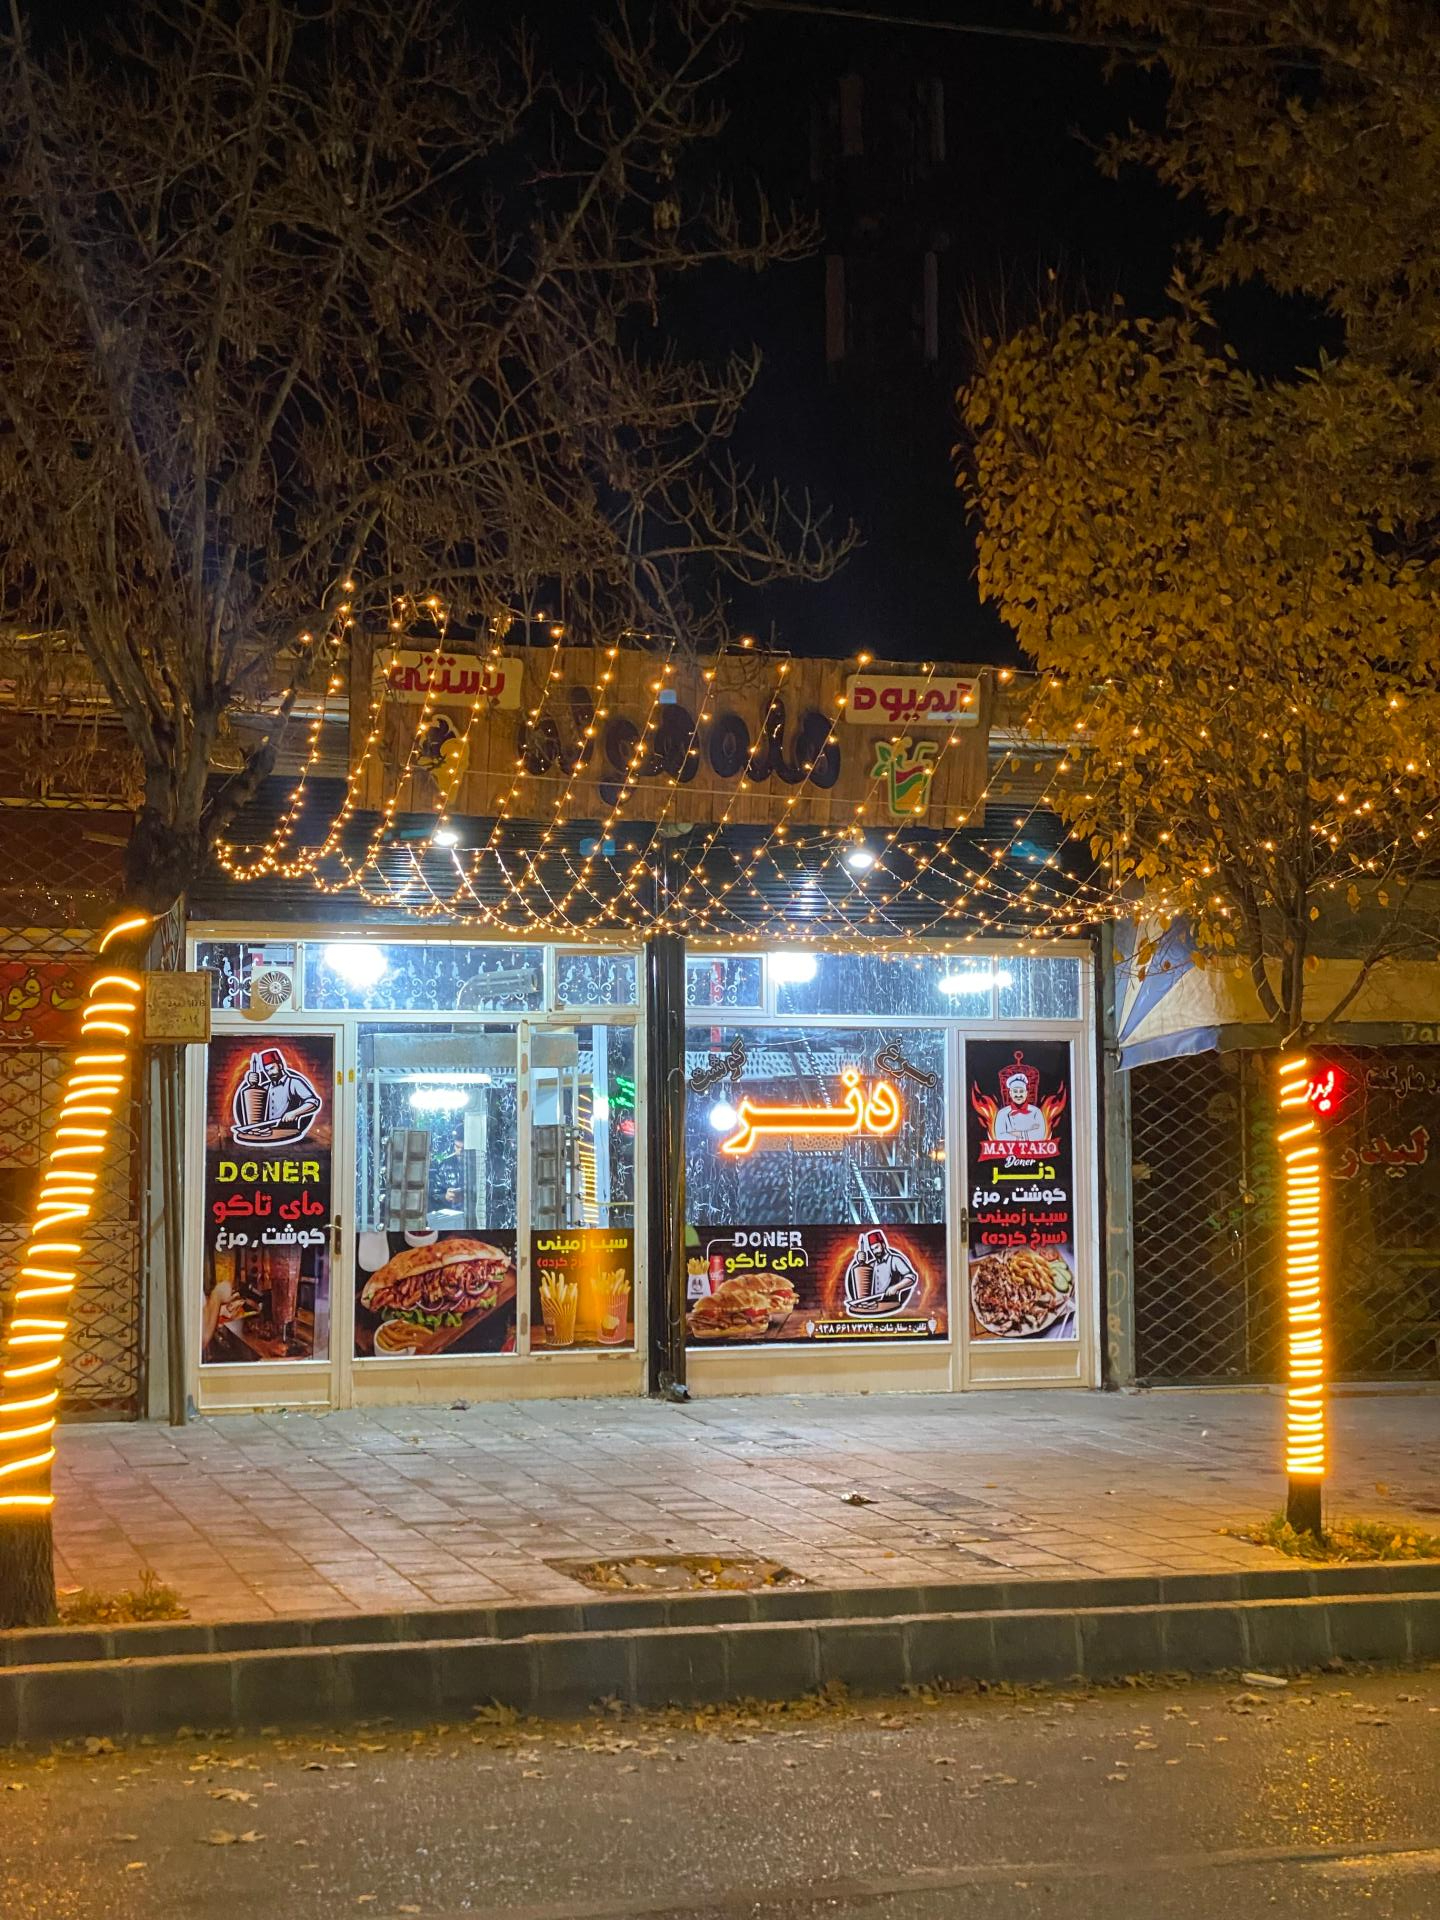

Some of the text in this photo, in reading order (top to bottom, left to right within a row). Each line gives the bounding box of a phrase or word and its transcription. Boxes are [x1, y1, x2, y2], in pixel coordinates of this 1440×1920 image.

[387, 655, 506, 707] بستنی
[854, 682, 972, 723] آبمیوه
[689, 1036, 747, 1094] گوشت
[875, 1037, 937, 1088] مرغ
[721, 1069, 900, 1154] دنر
[983, 1142, 1057, 1155] MAY TAKO
[215, 1160, 320, 1184] DONER
[991, 1161, 1056, 1185] دنر
[1004, 1154, 1036, 1168] Doner
[212, 1190, 324, 1224] مای تاکو
[972, 1186, 1000, 1208] مرغ
[977, 1208, 1068, 1227] سیب زمینی
[215, 1226, 248, 1252] مرغ
[537, 1235, 628, 1254] سیب زمینی
[732, 1231, 802, 1248] DONER
[725, 1250, 805, 1273] مای تاکو
